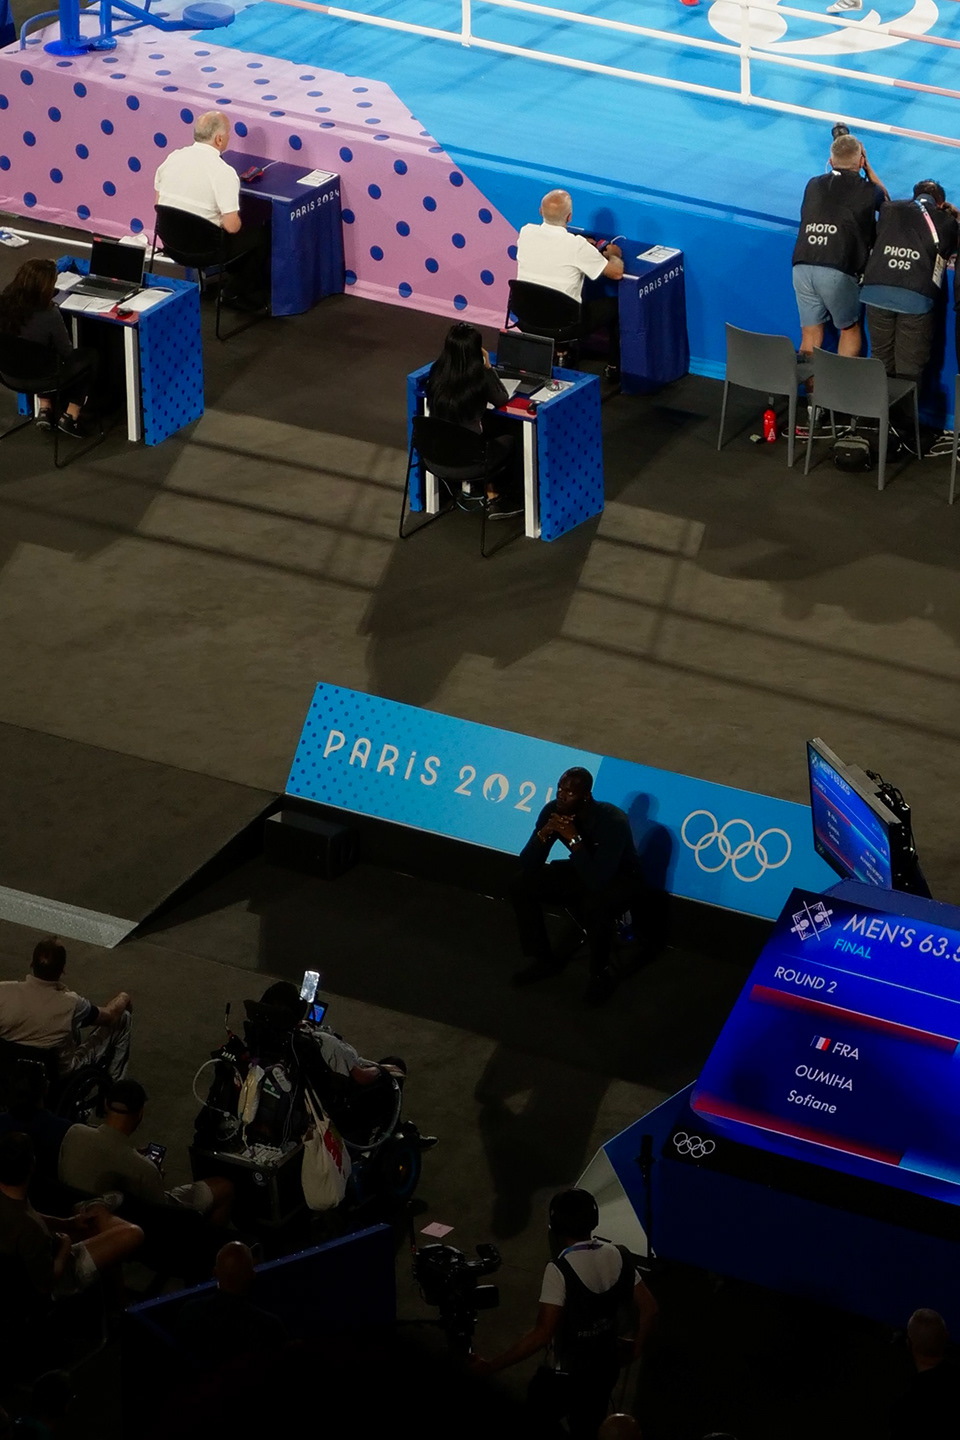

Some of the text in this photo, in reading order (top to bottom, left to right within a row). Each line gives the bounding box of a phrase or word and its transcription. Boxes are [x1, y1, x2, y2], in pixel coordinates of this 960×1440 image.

[316, 189, 340, 207] 2024
[805, 223, 837, 235] PHOTO
[808, 235, 828, 246] 091
[883, 245, 921, 260] PHOTO
[888, 258, 911, 271] 095
[663, 265, 684, 283] 2024
[842, 913, 917, 949] MEN'S
[833, 938, 872, 959] FINAL
[774, 966, 838, 994] ROUND 2
[832, 1042, 859, 1060] FRA
[795, 1064, 853, 1092] OUMIHA
[787, 1089, 837, 1114] Sofiane
